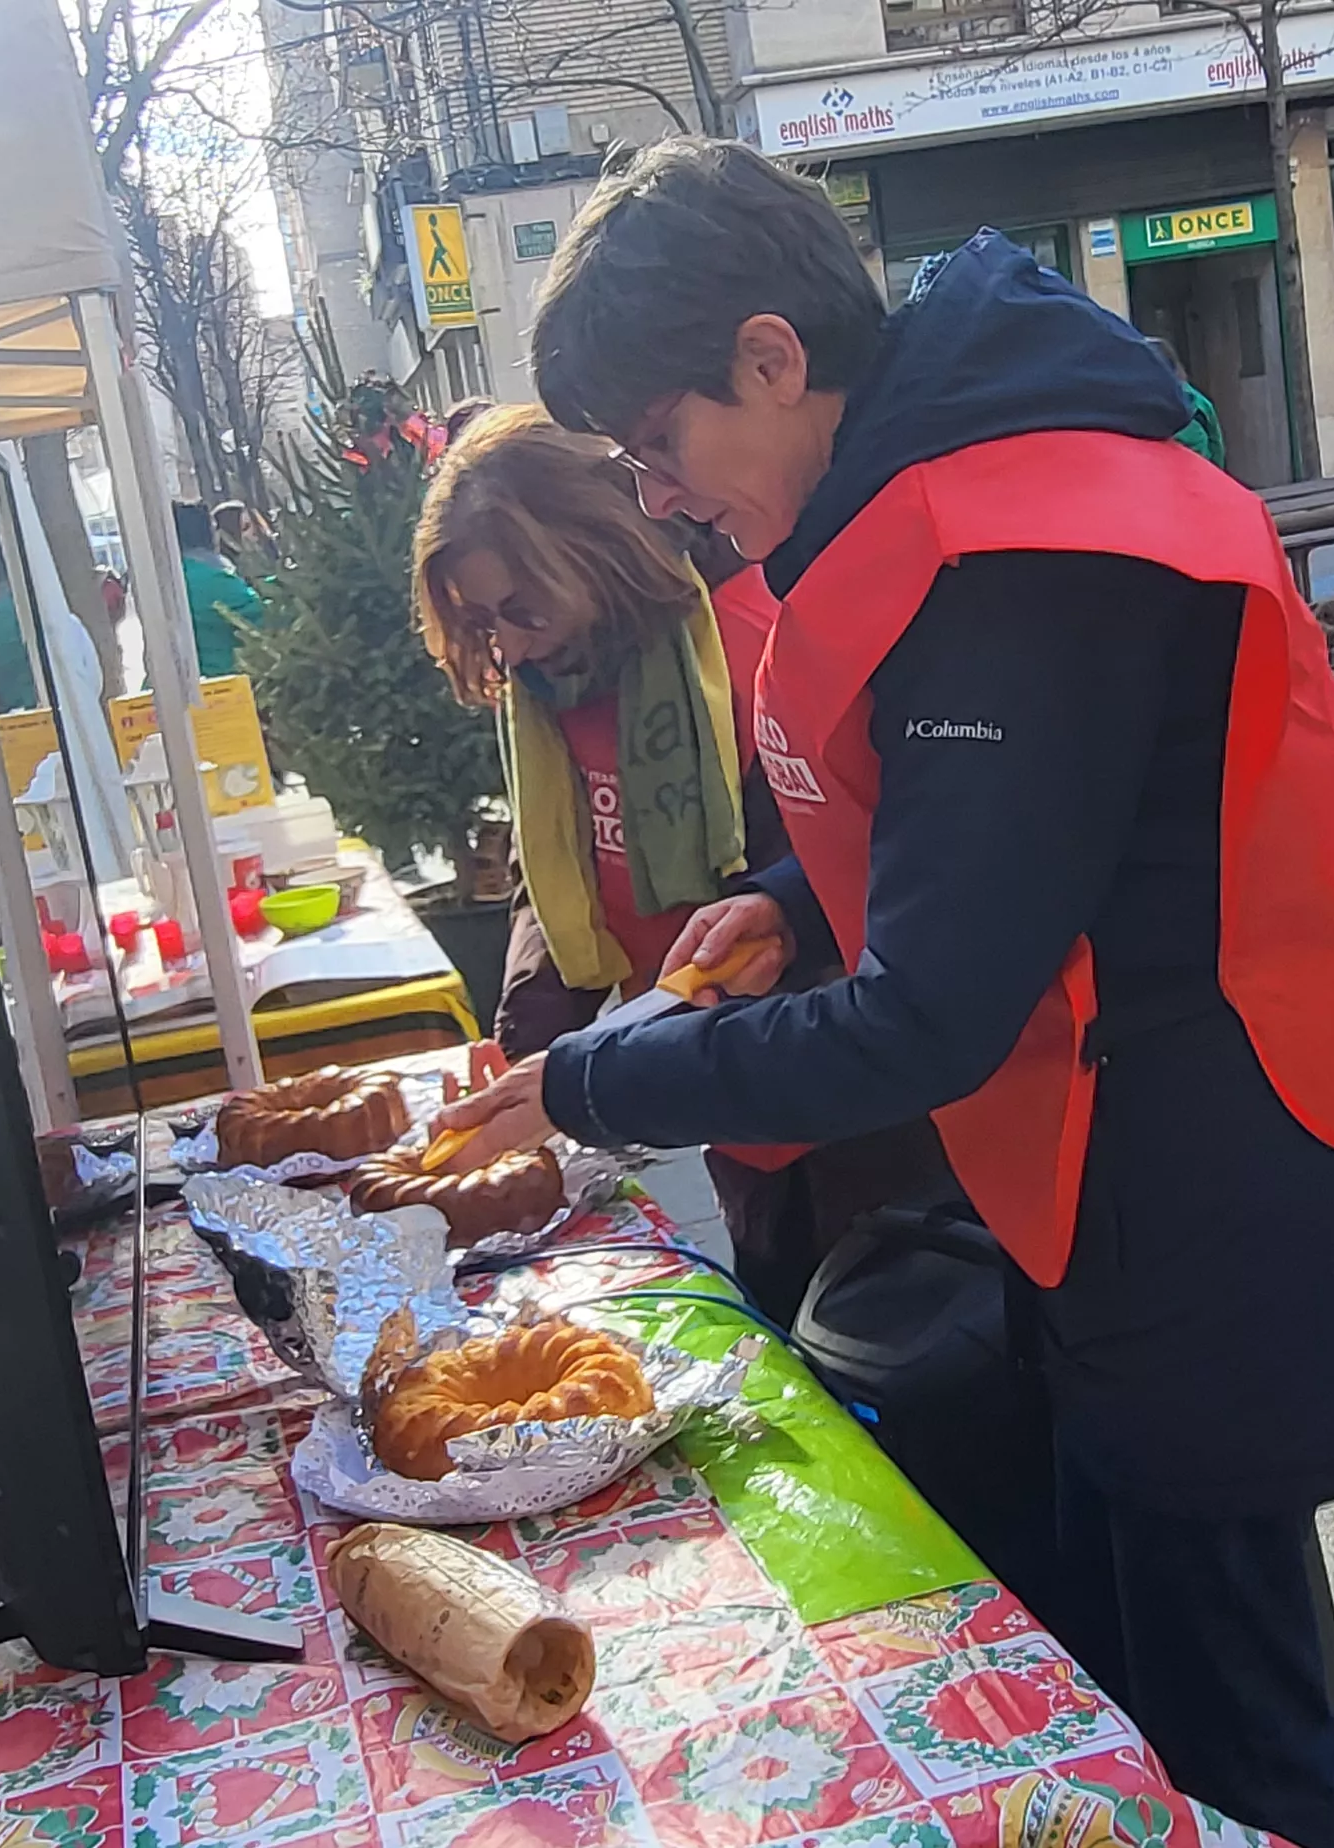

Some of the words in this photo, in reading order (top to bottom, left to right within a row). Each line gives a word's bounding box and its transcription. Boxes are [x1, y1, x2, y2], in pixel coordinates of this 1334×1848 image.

[1073, 52, 1108, 67] desde
[1111, 48, 1129, 61] los
[1133, 46, 1140, 58] 4
[1143, 43, 1172, 56] años
[1000, 77, 1042, 92] niveles
[980, 88, 1120, 118] www.englishmaths.com
[780, 112, 837, 147] english
[844, 105, 894, 132] maths
[1179, 209, 1244, 234] ONCE
[427, 284, 471, 303] ONCE
[916, 720, 1002, 741] Columbia
